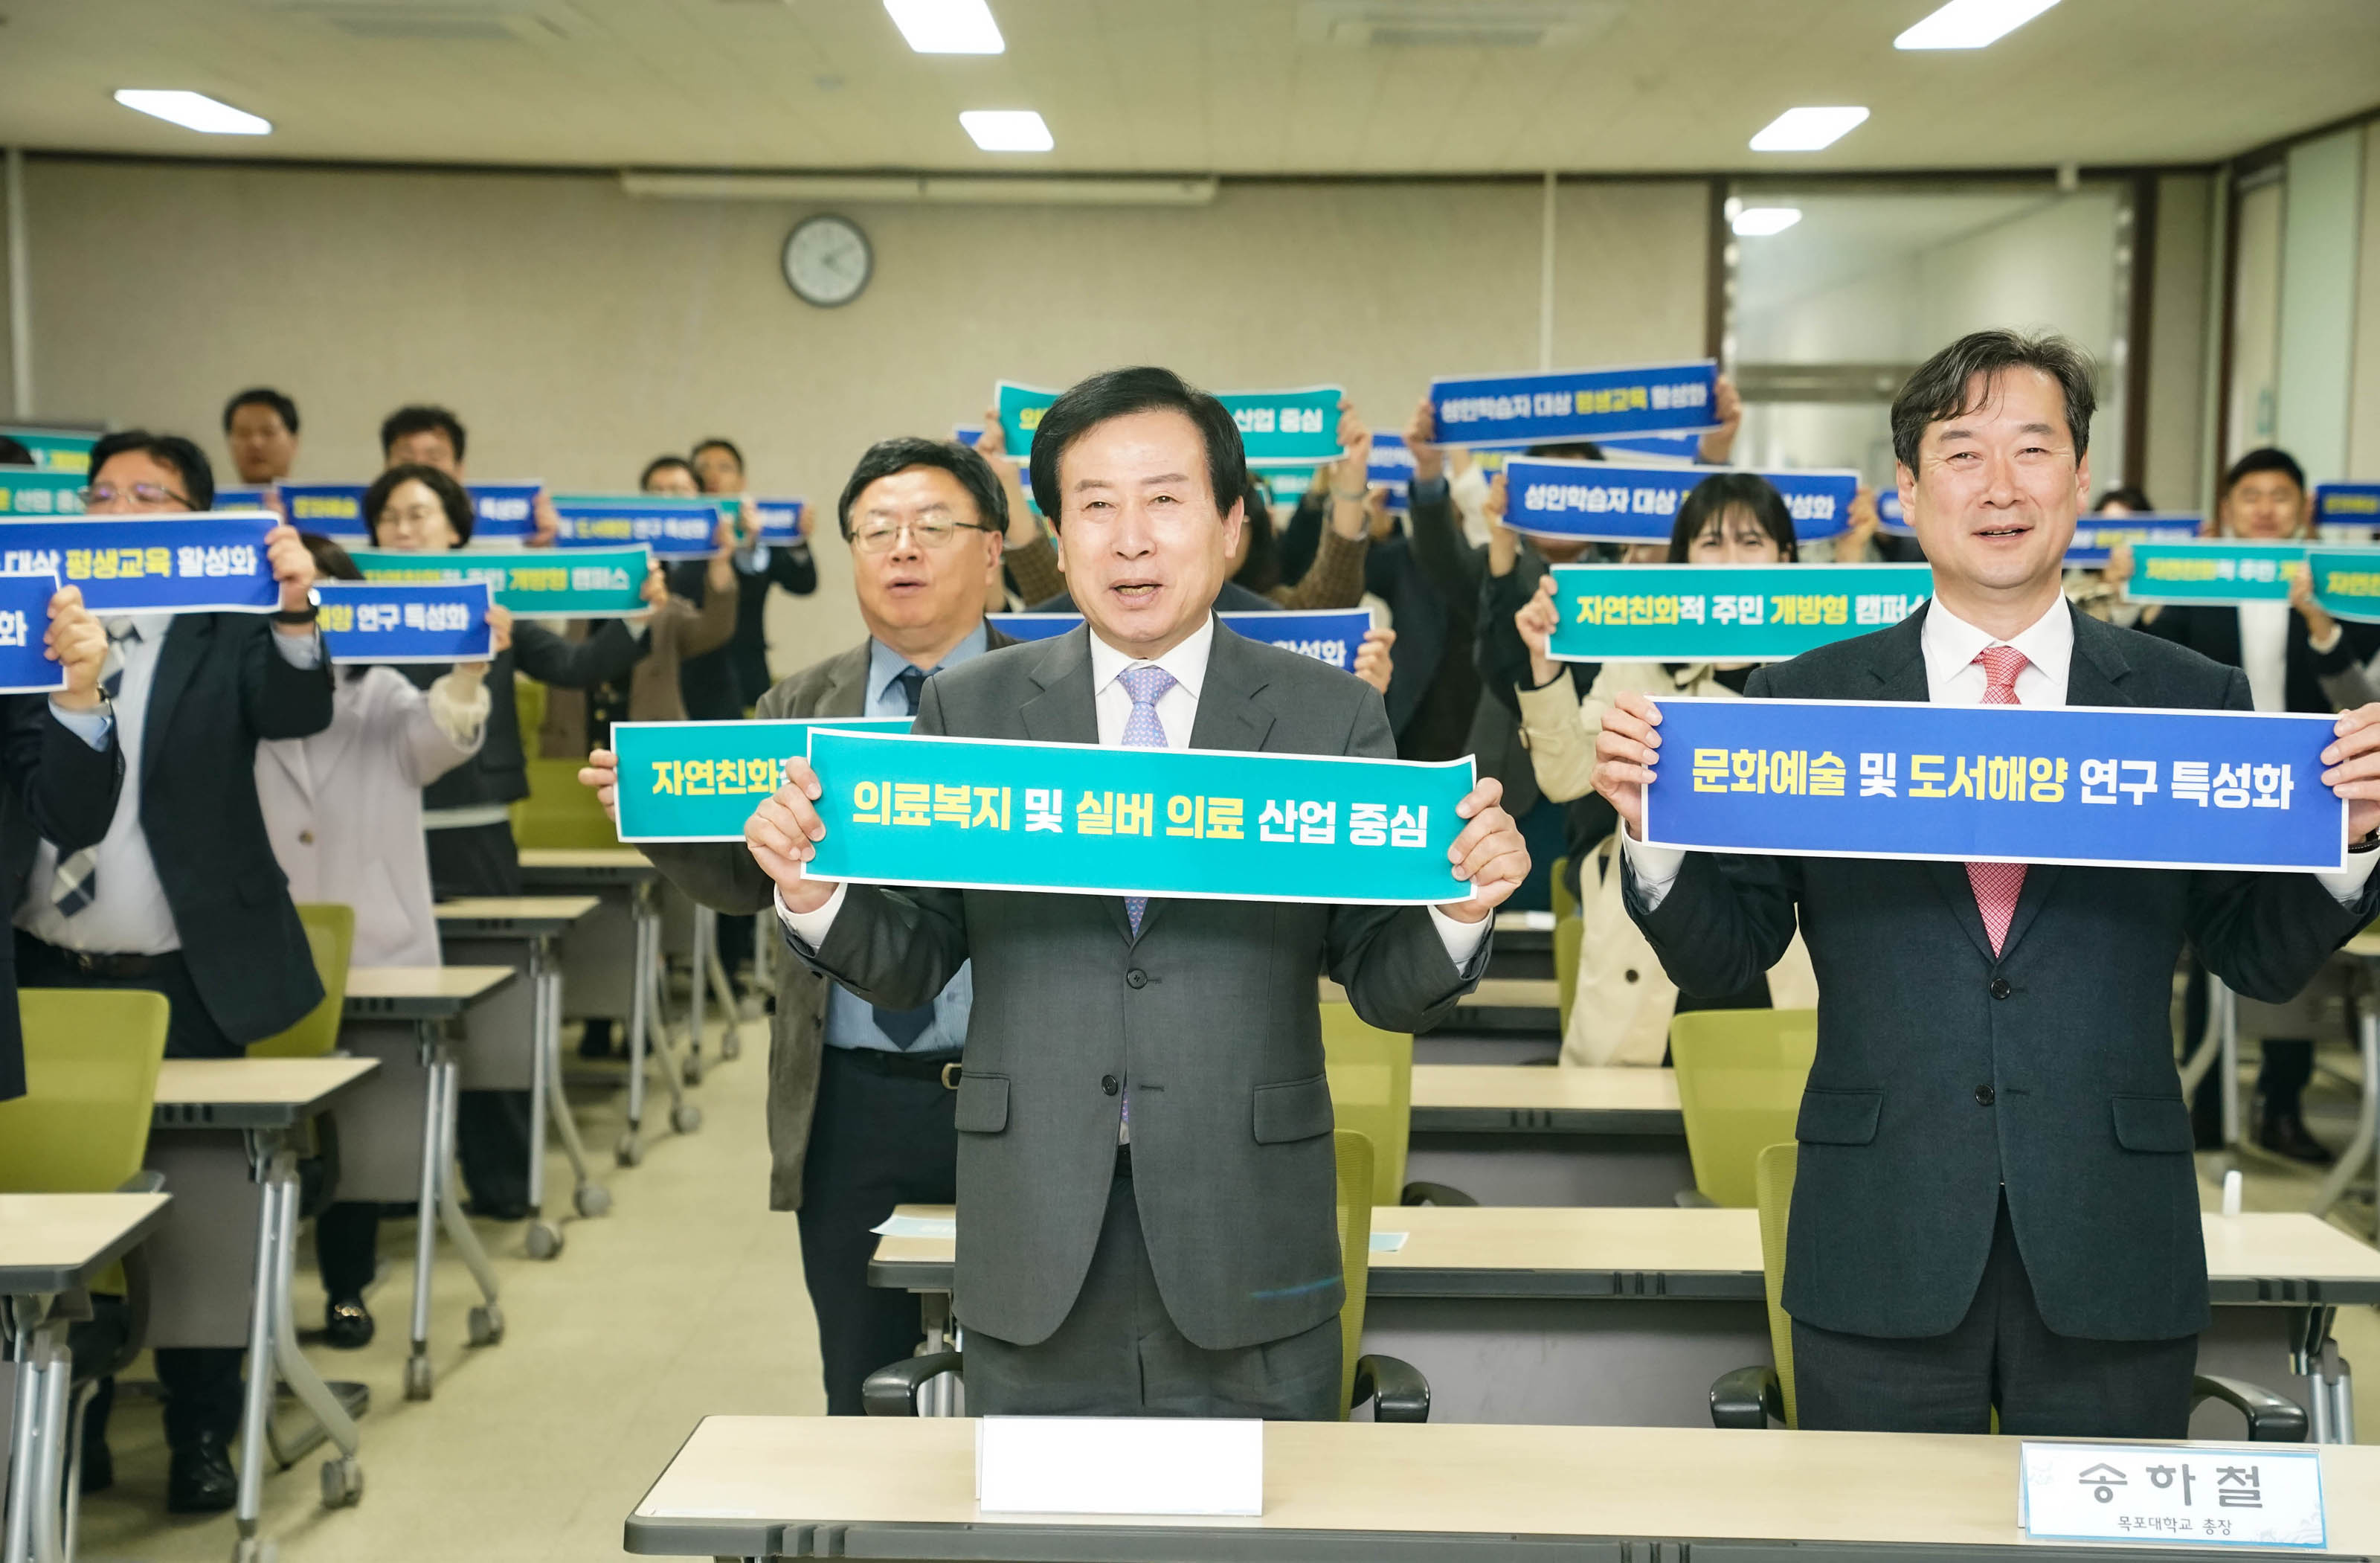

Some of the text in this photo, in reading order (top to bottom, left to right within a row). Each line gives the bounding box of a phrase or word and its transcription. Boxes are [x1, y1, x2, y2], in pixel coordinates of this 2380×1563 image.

[1534, 390, 1572, 417] 대상
[1279, 408, 1323, 433] 중심
[1525, 484, 1630, 514] 성인학습자
[1633, 488, 1677, 516] 대상
[65, 548, 172, 580] 평생교육
[177, 545, 258, 578] 활성화
[357, 603, 400, 632] 연구
[404, 603, 470, 632] 특성화
[1576, 594, 1705, 626] 자연친화적
[1712, 595, 1763, 626] 주민
[1769, 594, 1848, 626] 개방형
[652, 758, 791, 797] 자연친화
[1692, 747, 2294, 810] 문화예술 및 도서해양 연구 특성화
[853, 780, 1428, 848] 의료복지 및 실버 의료 산업 중심
[2117, 1515, 2233, 1535] 목포대학교 총장
